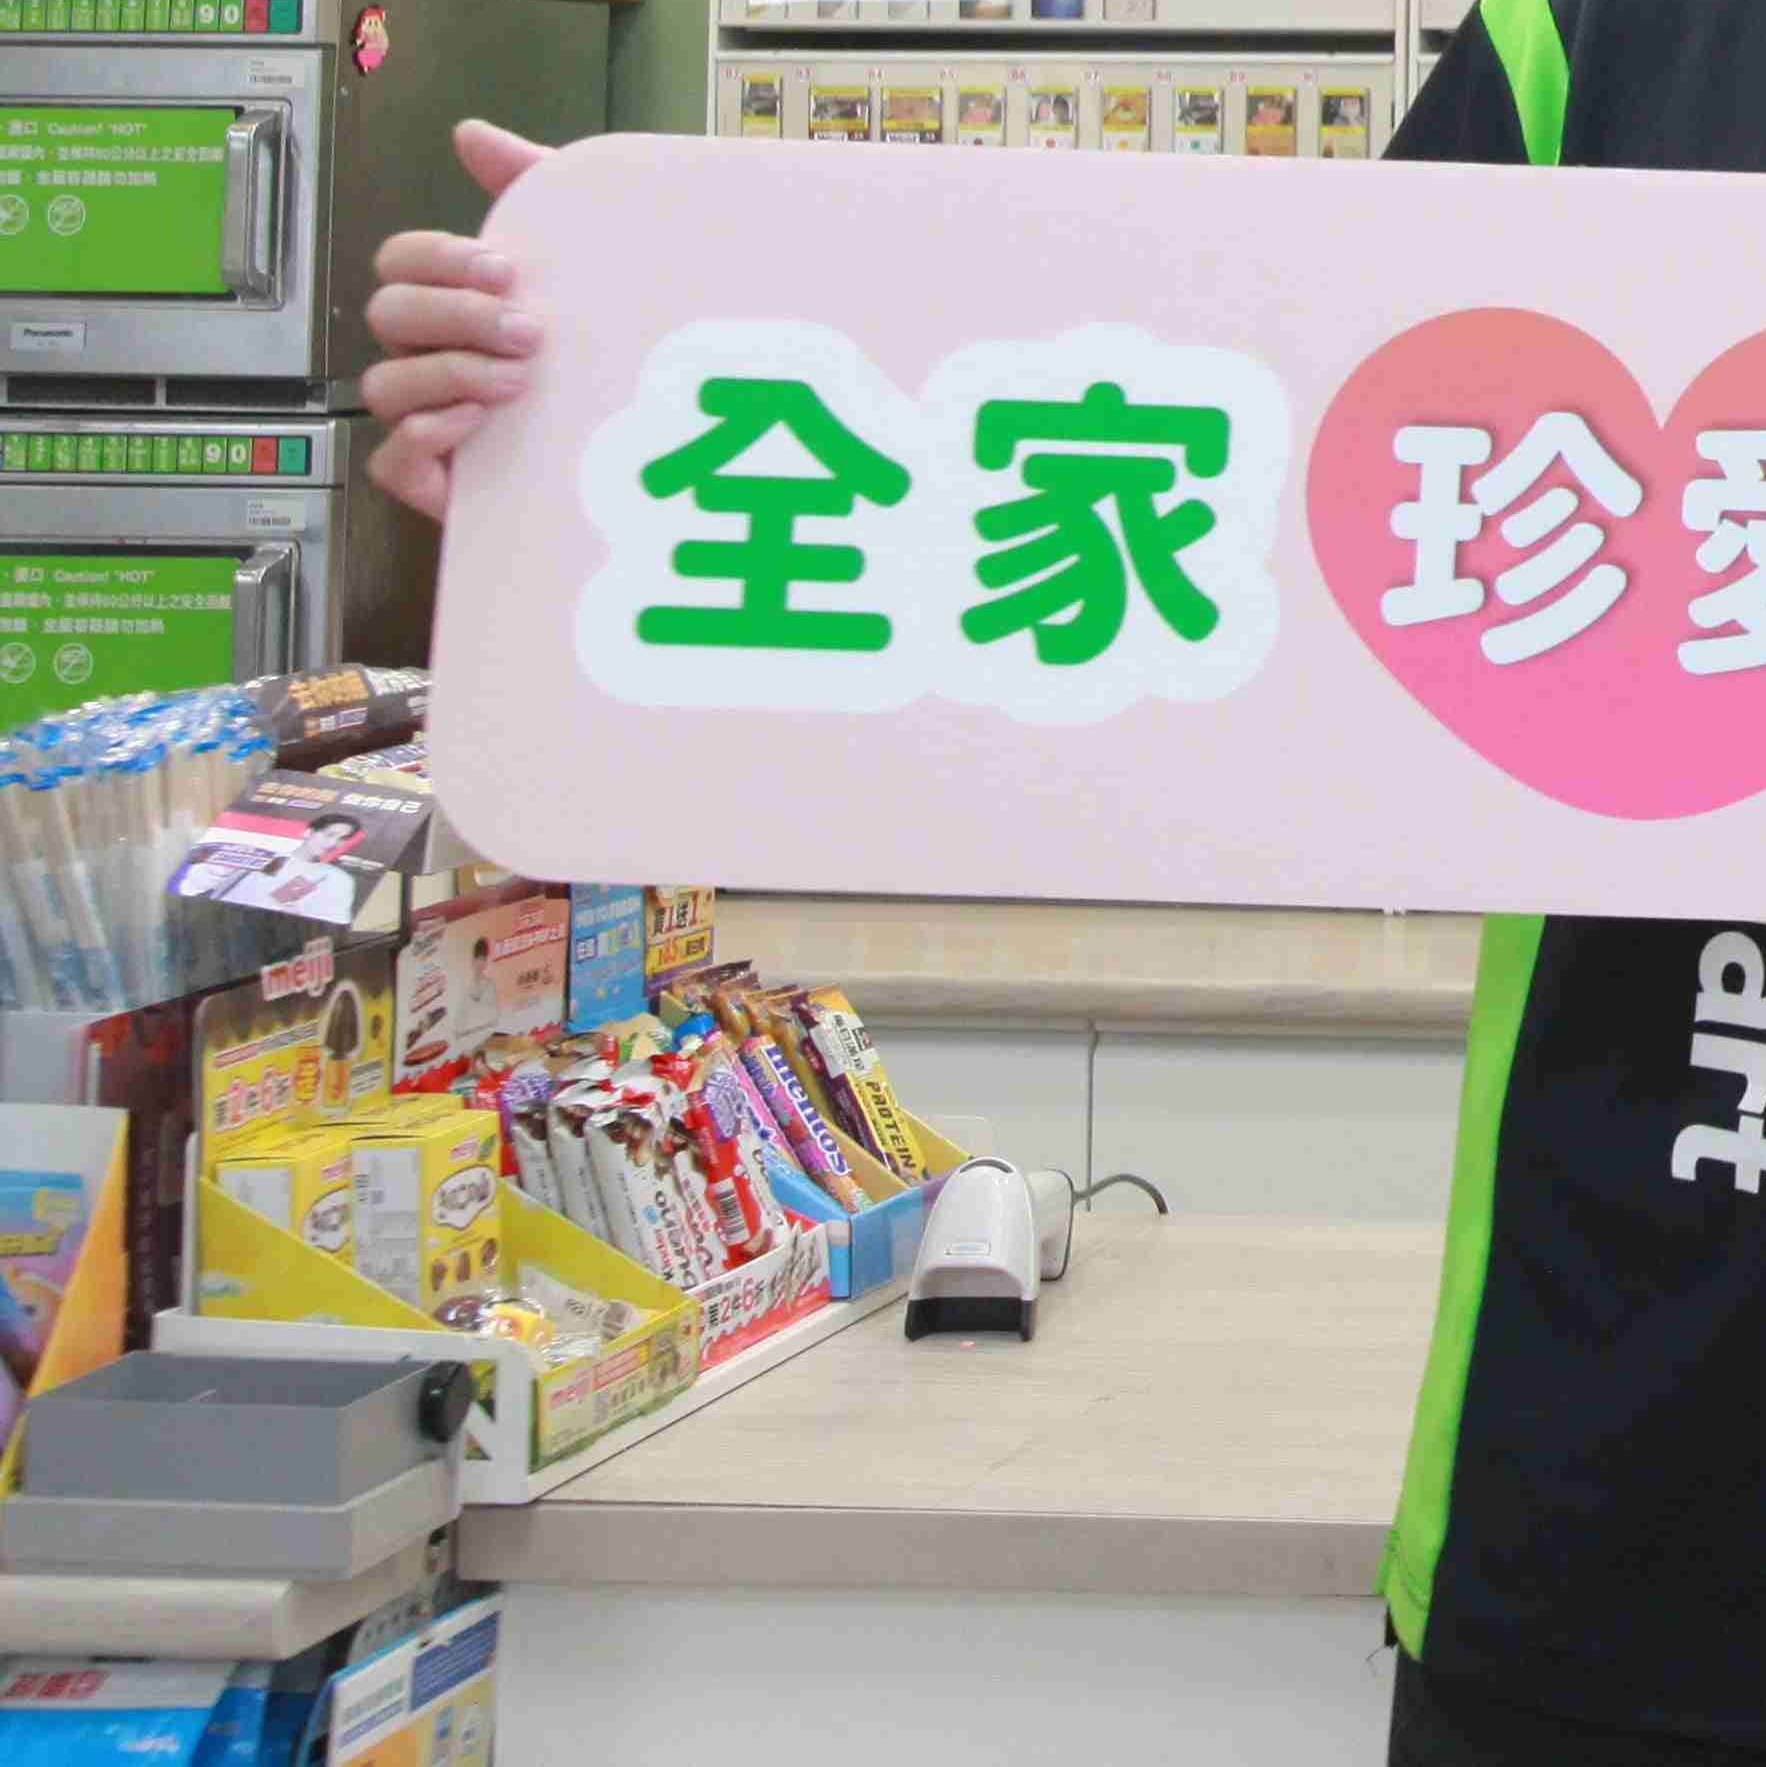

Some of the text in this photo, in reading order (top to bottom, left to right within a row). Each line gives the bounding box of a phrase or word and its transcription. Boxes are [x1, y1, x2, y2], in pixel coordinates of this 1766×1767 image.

[198, 4, 240, 25] 9 0
[22, 328, 73, 339] Panasonic
[205, 443, 247, 464] 9 0
[636, 372, 1232, 670] 全家
[263, 952, 334, 998] meiji
[762, 1046, 849, 1176] mentos
[865, 1081, 917, 1169] PROTEIN
